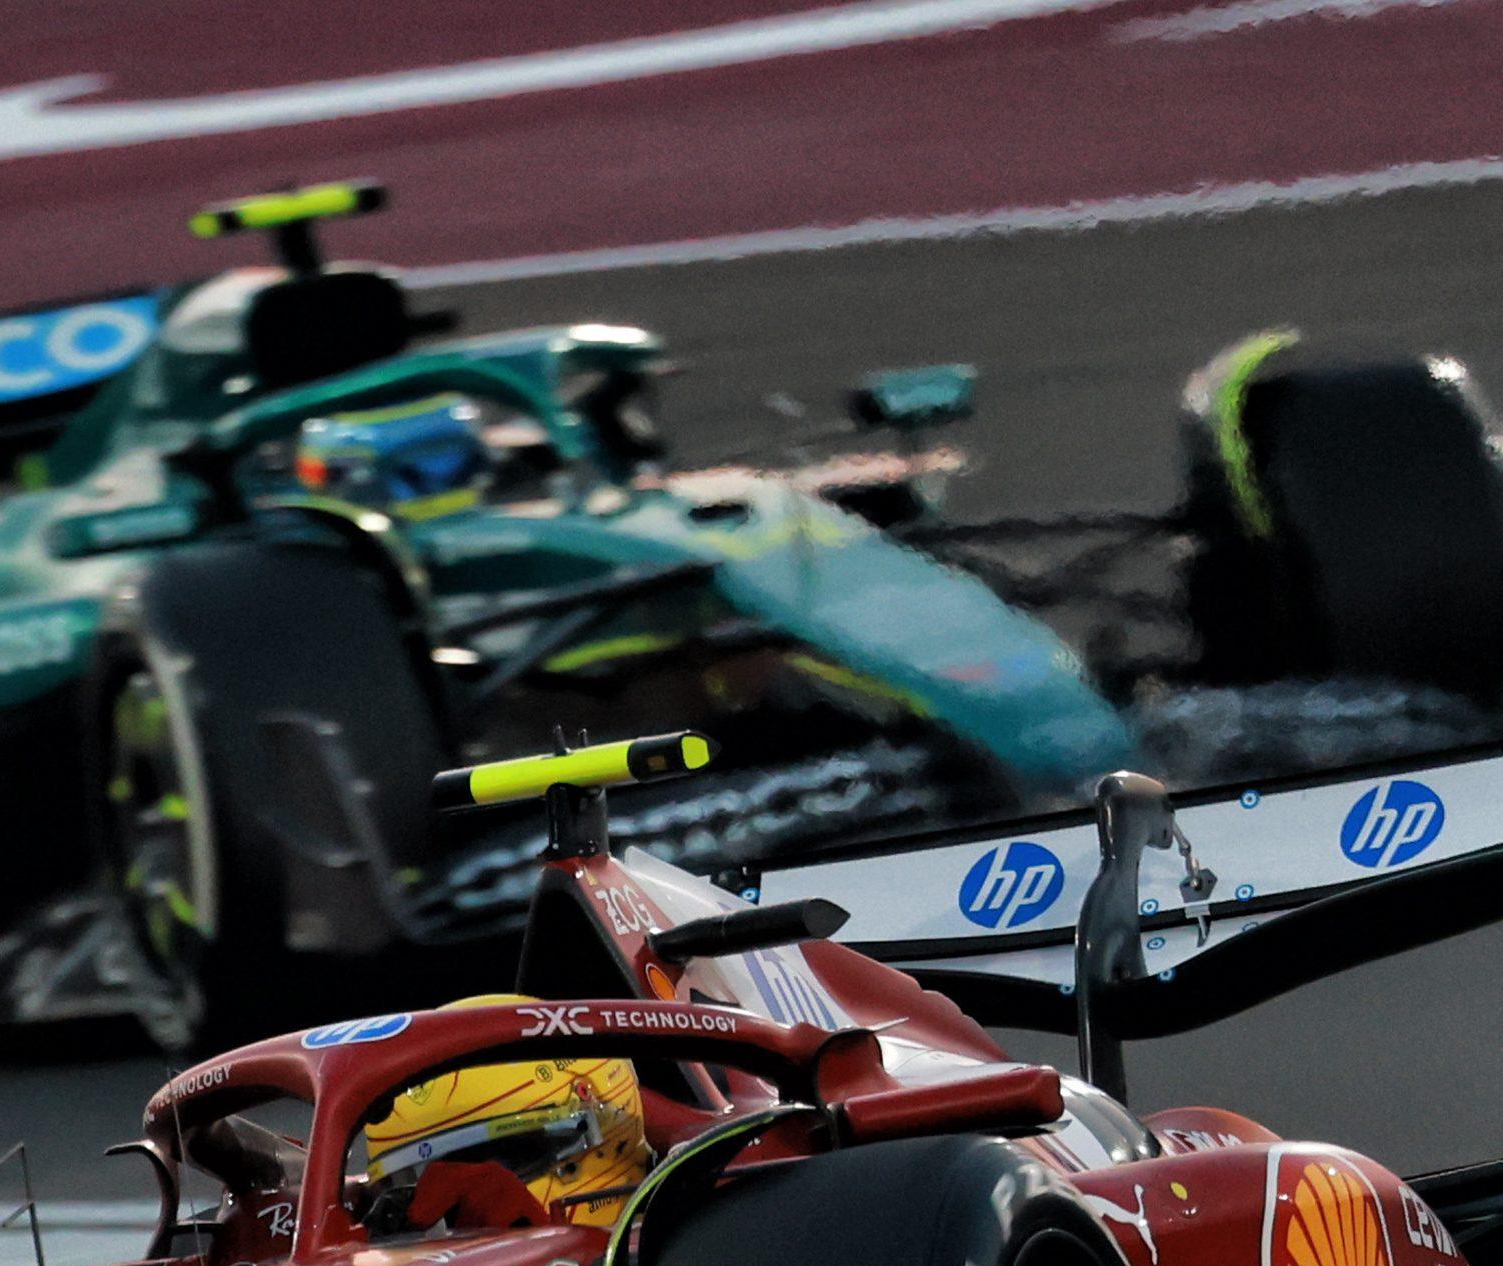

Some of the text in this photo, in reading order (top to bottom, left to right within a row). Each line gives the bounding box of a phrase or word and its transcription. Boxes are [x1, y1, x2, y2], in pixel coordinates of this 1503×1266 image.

[1349, 779, 1438, 868] hp
[969, 841, 1057, 929] hp
[516, 1006, 737, 1036] DXC TECHNOLOGY
